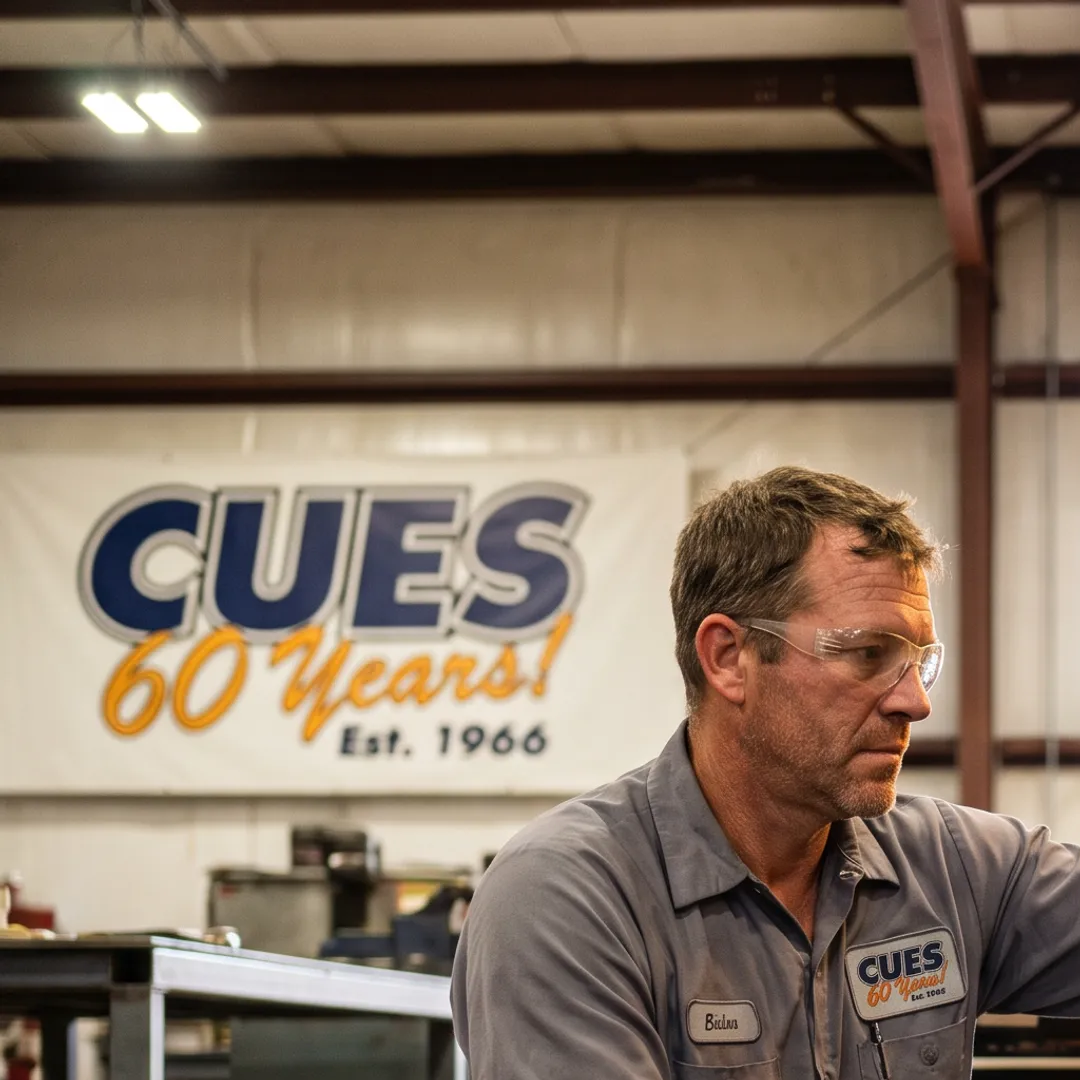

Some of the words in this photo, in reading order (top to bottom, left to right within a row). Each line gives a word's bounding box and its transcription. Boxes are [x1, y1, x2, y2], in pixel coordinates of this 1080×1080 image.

[77, 480, 593, 646] CUES
[101, 624, 249, 737] 60
[269, 613, 573, 742] Years!
[339, 725, 412, 757] Est.
[438, 723, 548, 756] 1966
[857, 940, 945, 986] CUES
[867, 980, 892, 1007] 60
